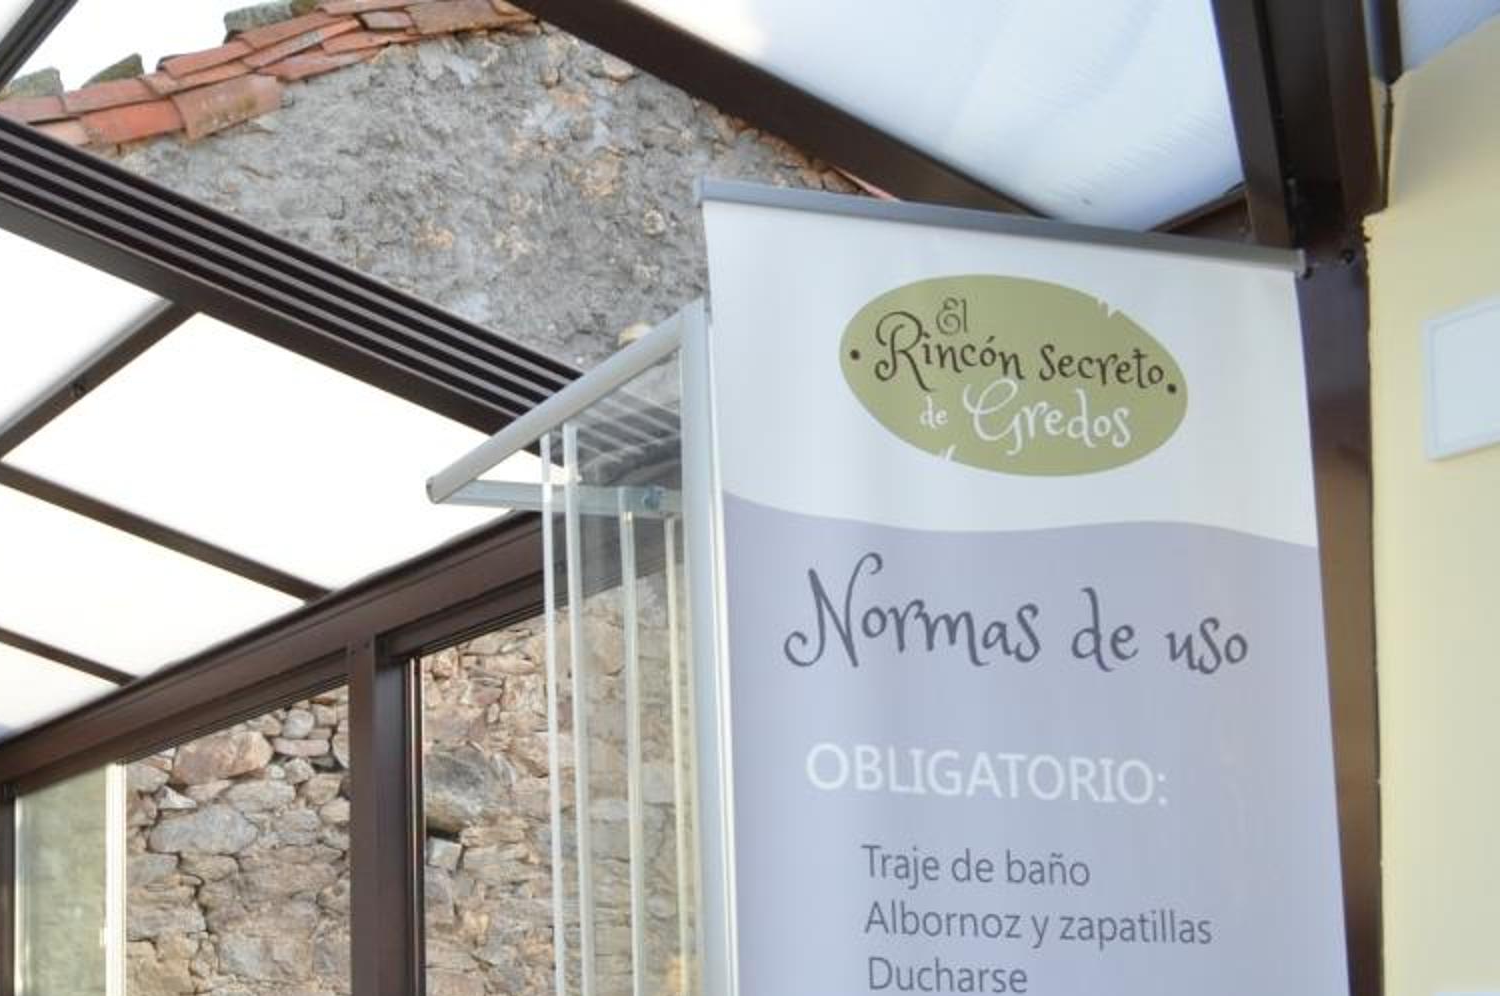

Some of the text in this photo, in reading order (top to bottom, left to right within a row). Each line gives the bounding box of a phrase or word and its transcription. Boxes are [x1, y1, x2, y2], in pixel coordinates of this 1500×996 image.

[936, 298, 968, 335] El
[875, 311, 1025, 392] Rincón
[920, 377, 1132, 455] de Gredos
[784, 552, 1248, 674] Normas de uso
[806, 743, 1168, 805] OBLIGATORIO:
[862, 845, 1090, 889] Traje de baño
[865, 901, 1212, 950] Albornoz y zapatillas
[868, 957, 1028, 994] Ducharse
